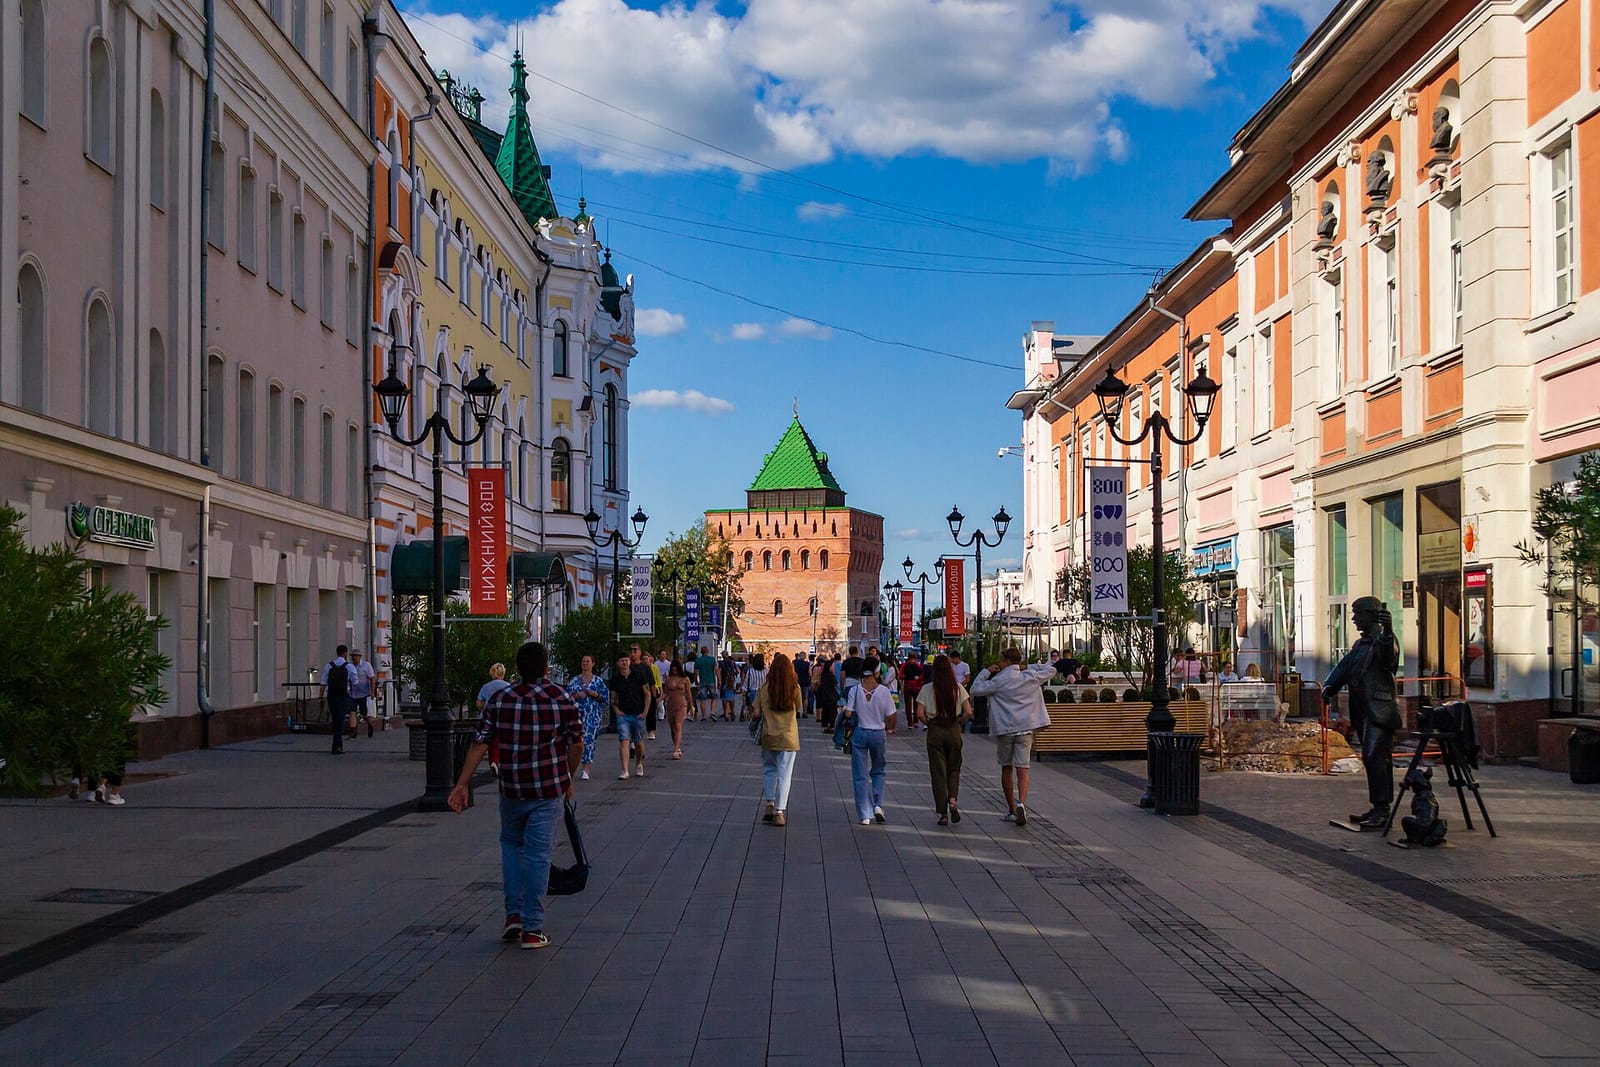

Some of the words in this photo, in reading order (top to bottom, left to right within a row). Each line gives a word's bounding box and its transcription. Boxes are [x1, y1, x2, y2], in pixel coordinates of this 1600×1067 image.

[480, 481, 494, 512] 800
[1093, 479, 1123, 494] 800
[93, 506, 155, 543] СБЕРБАНК
[478, 516, 495, 600] НИЖНИЙ
[1094, 557, 1124, 572] 800
[633, 578, 649, 587] 800
[949, 585, 959, 628] НИЖНИЙ
[633, 618, 650, 627] 800
